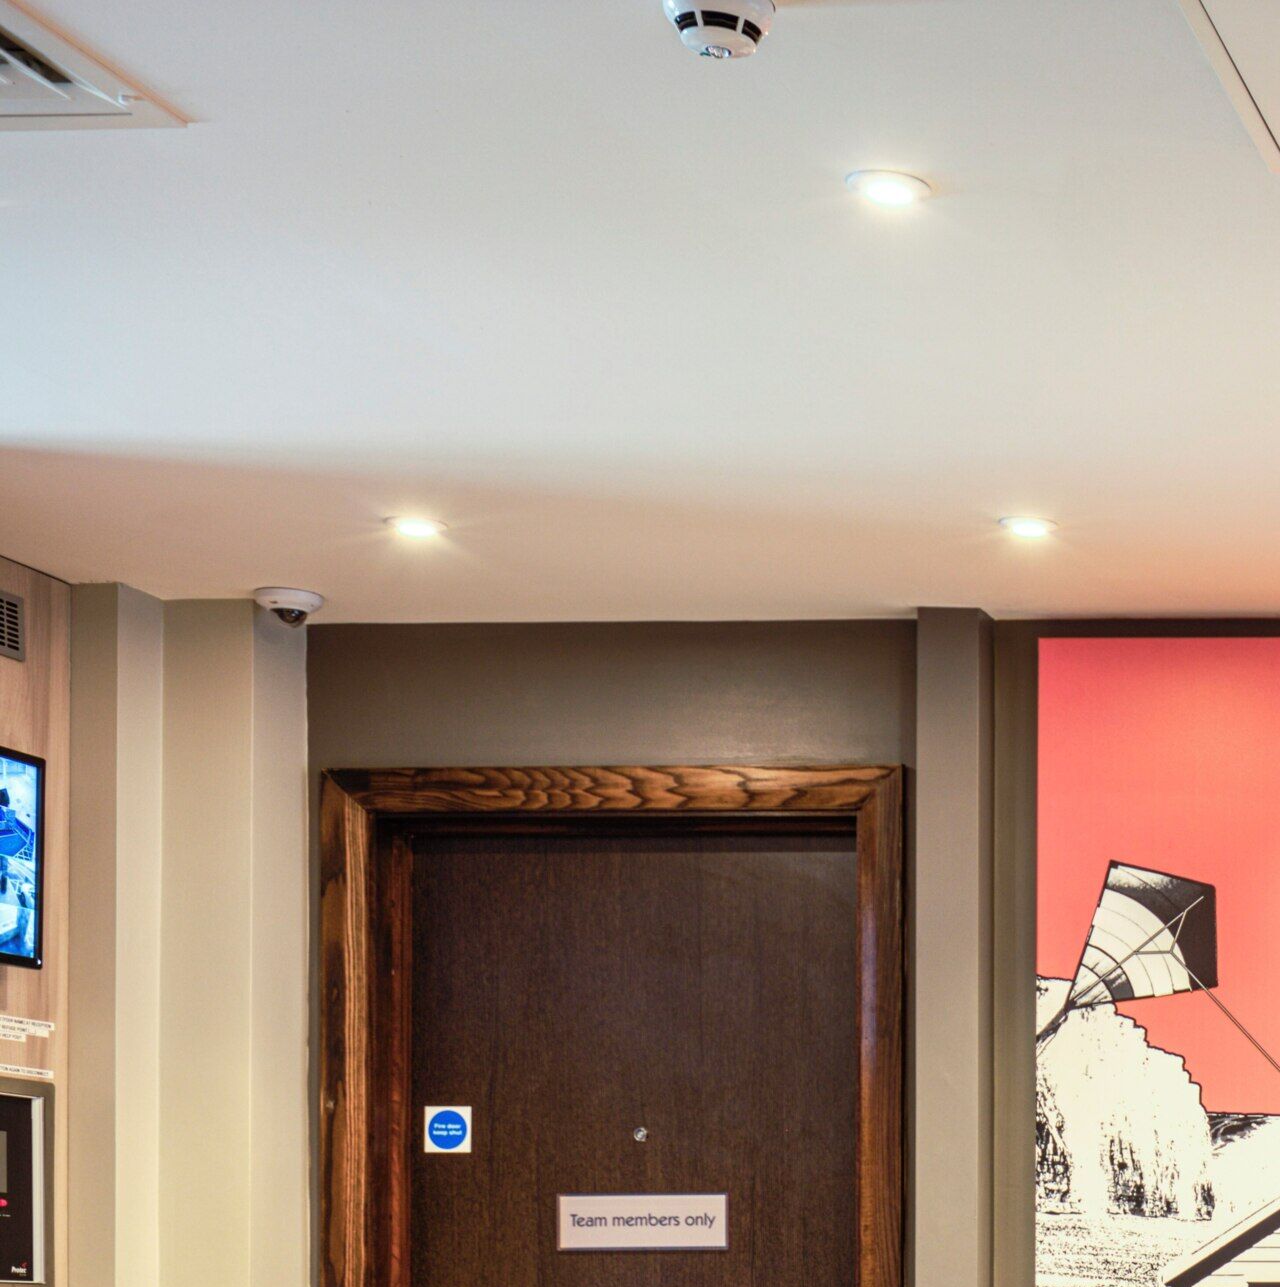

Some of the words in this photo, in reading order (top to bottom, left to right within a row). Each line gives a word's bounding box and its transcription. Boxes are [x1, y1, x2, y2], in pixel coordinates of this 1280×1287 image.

[570, 1214, 607, 1227] Team
[612, 1213, 680, 1227] members
[684, 1213, 716, 1229] only
